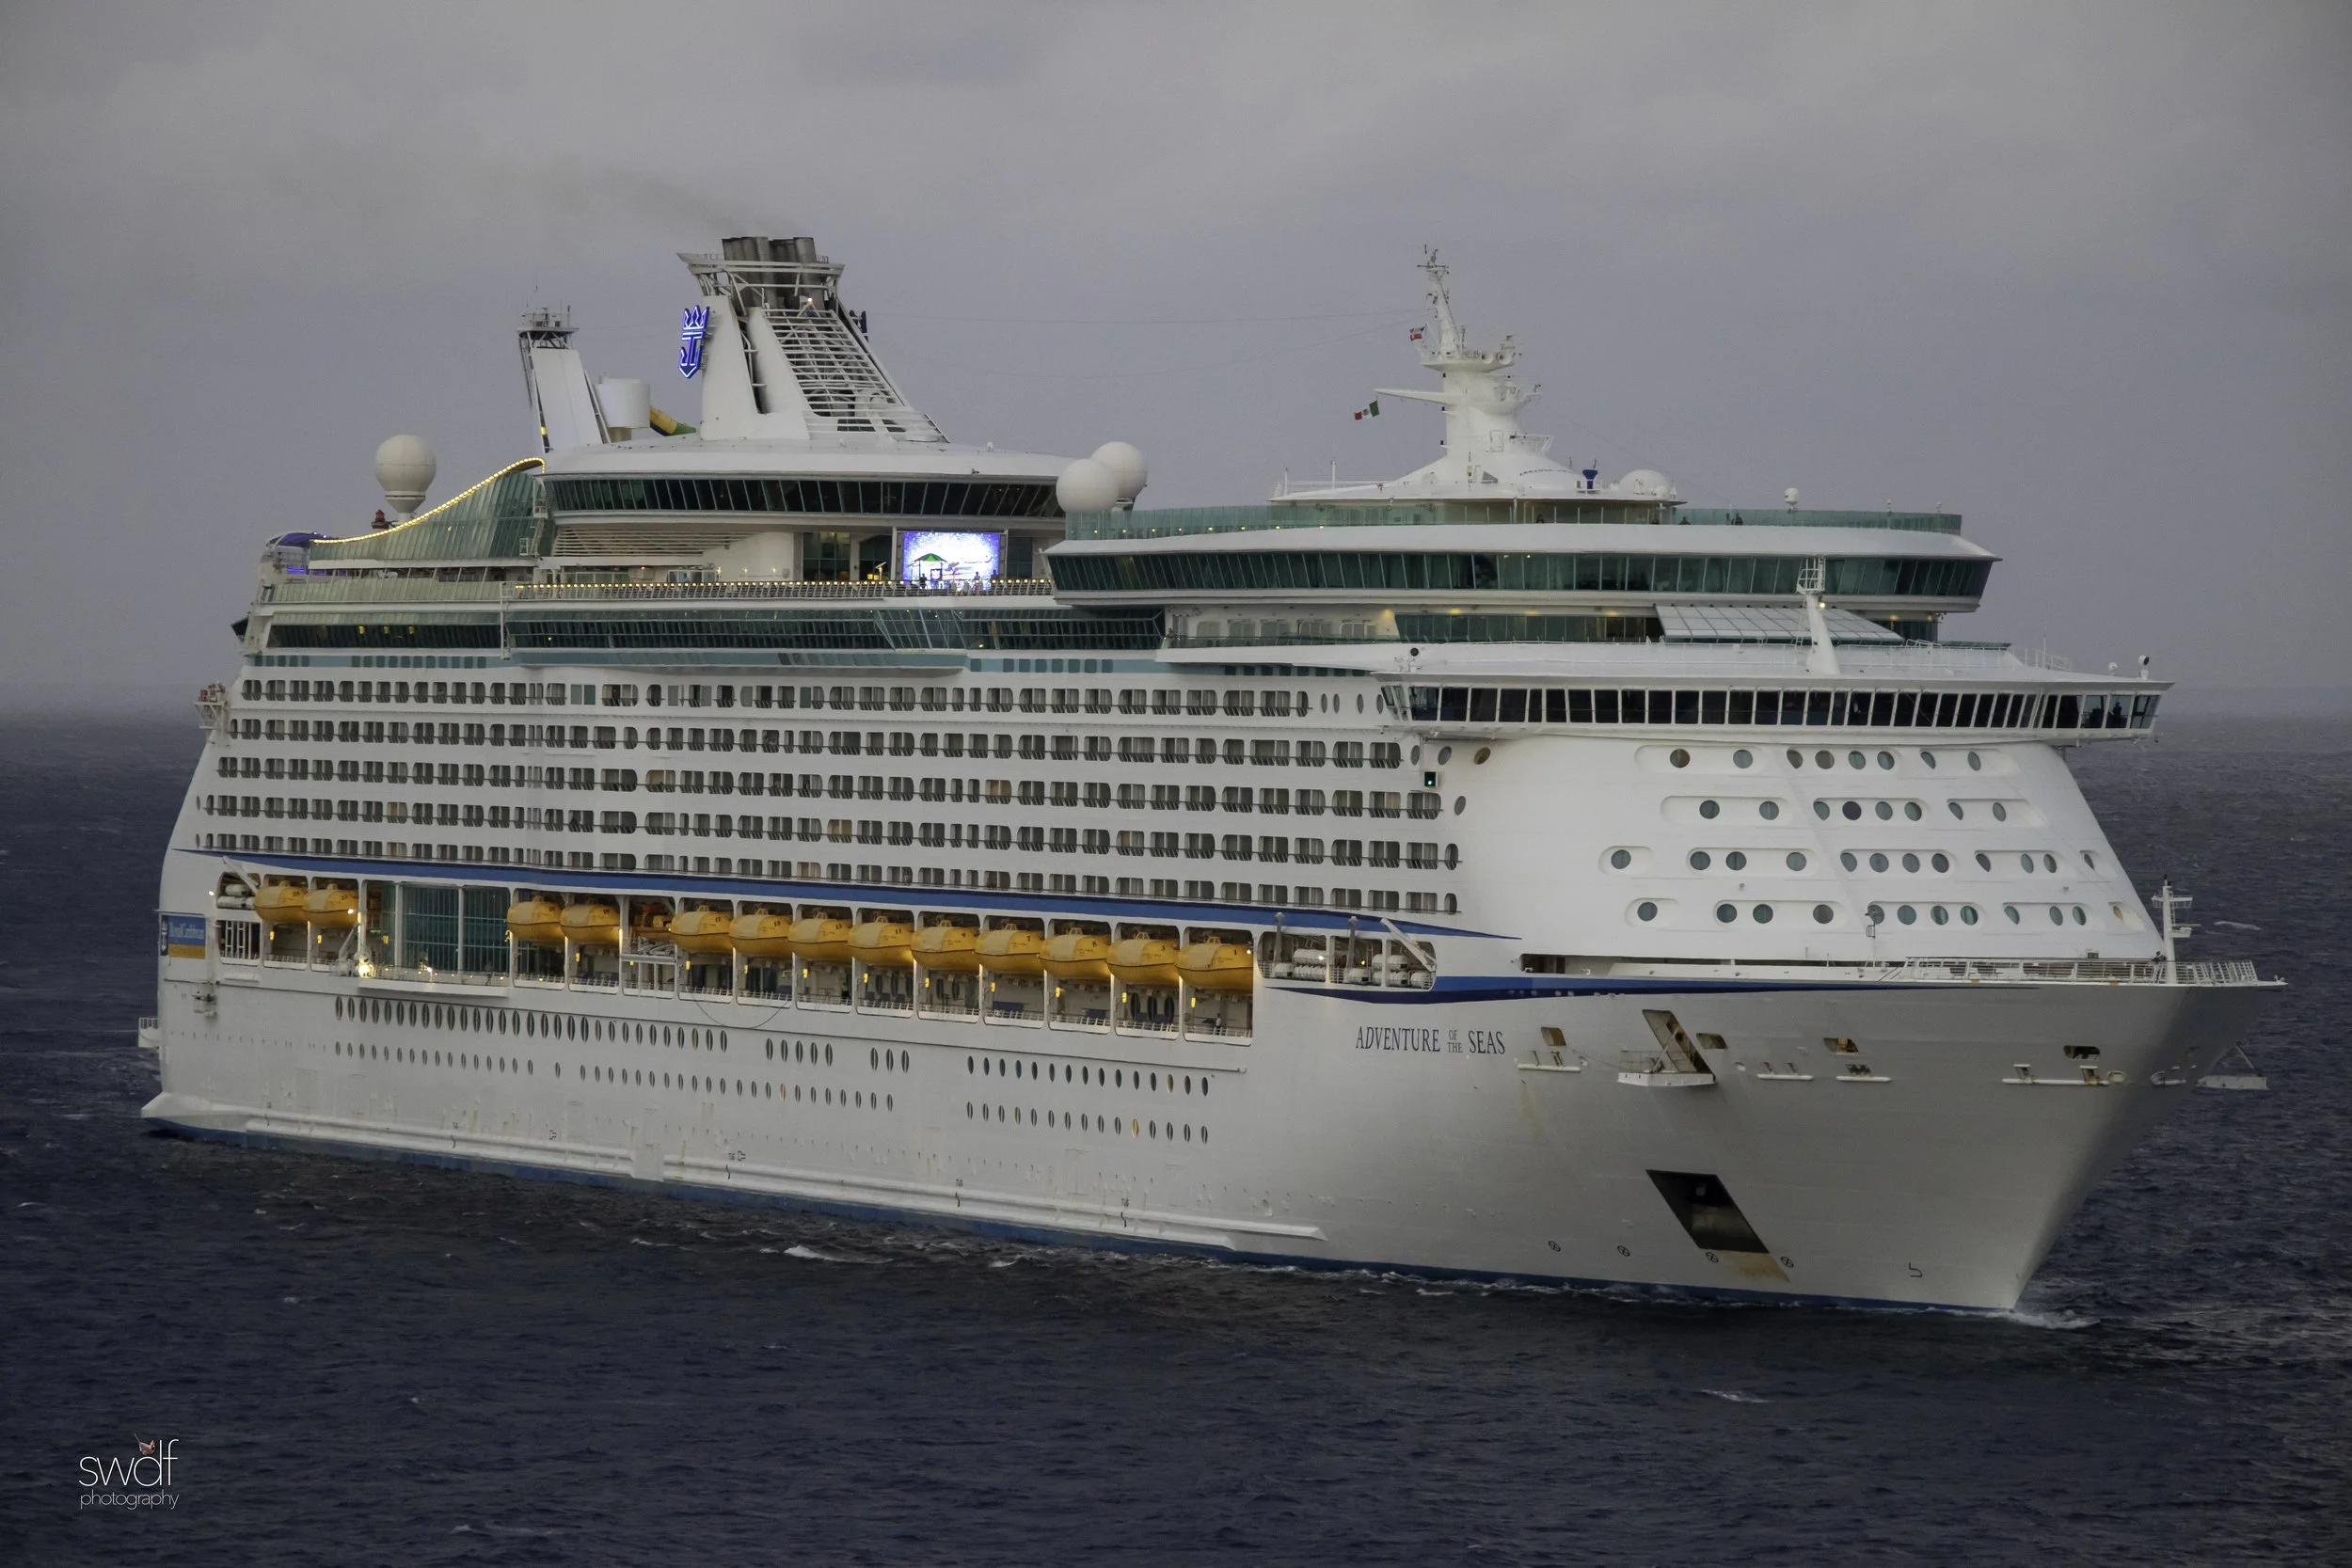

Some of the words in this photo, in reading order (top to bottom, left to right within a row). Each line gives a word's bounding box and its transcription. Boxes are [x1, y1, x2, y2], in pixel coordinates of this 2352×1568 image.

[1355, 1025, 1441, 1053] ADVENTURE
[1449, 1029, 1458, 1040] OF
[1468, 1030, 1506, 1055] SEAS
[1447, 1041, 1464, 1053] THE
